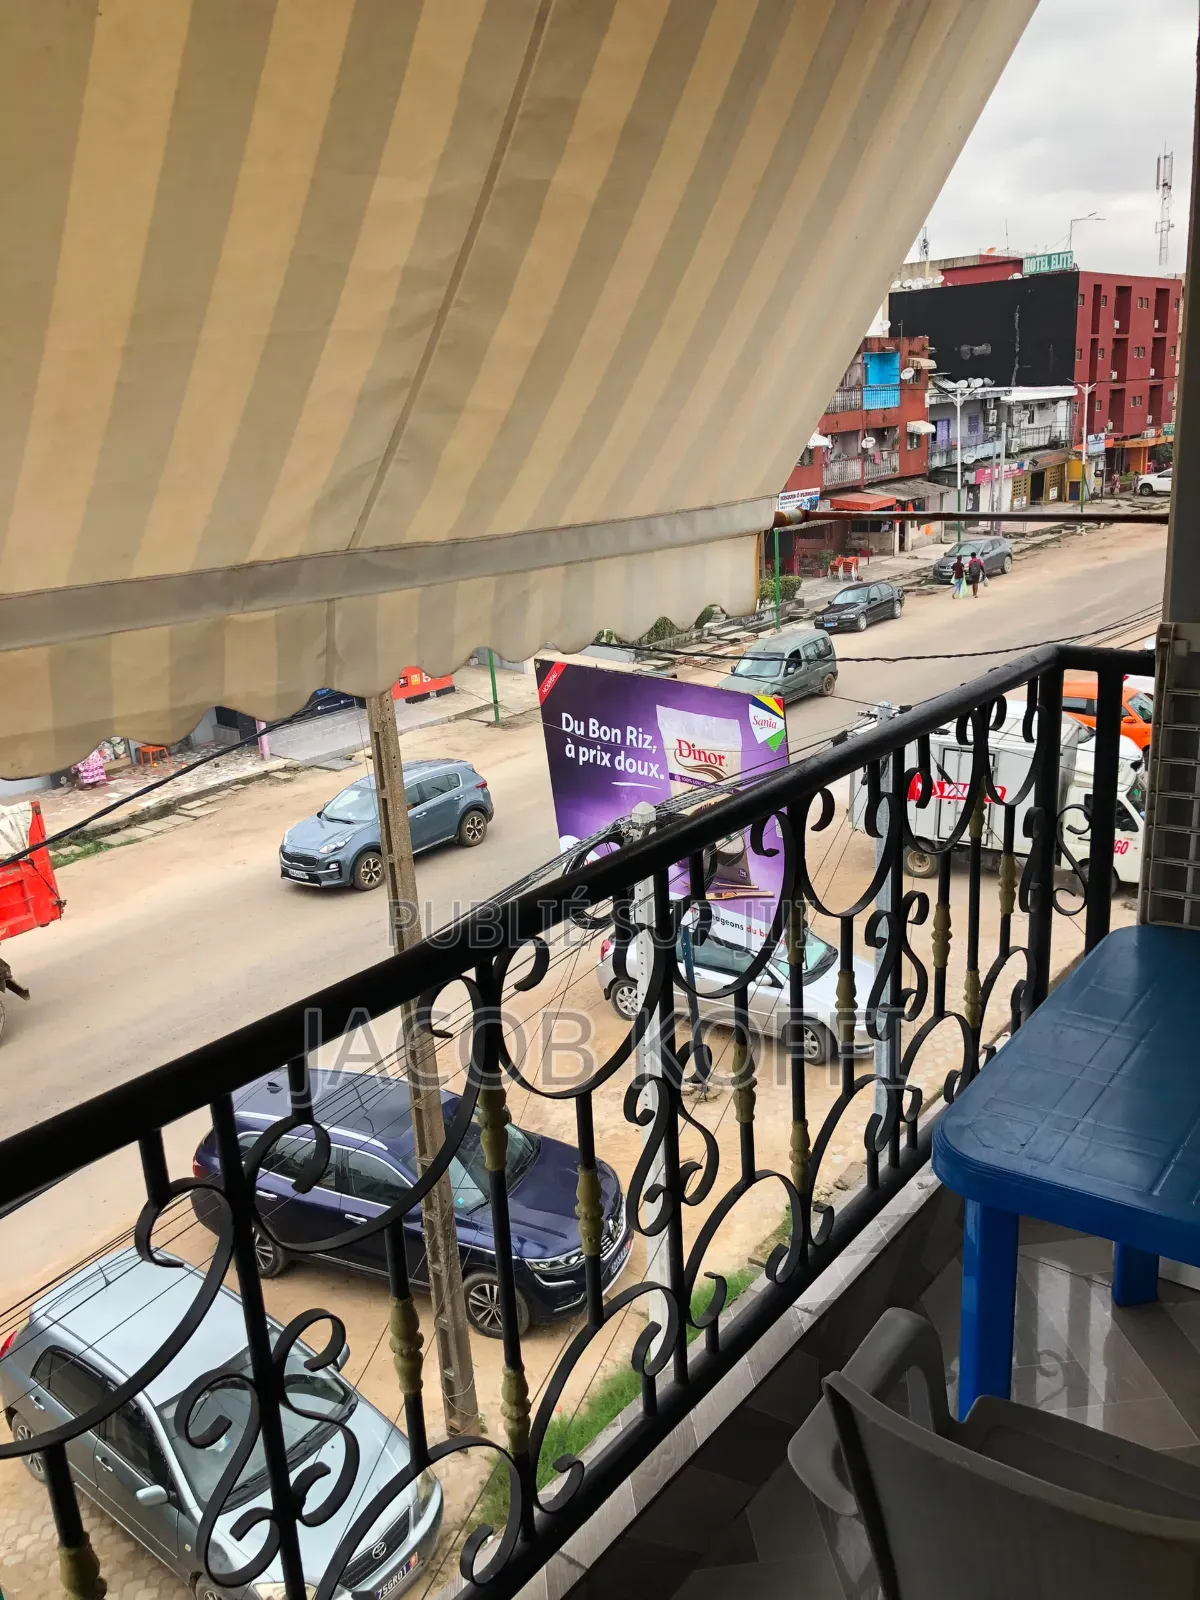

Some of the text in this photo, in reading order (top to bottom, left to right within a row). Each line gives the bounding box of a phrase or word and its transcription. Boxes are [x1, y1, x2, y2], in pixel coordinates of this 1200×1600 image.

[1024, 252, 1073, 272] HOTEL ELITE
[542, 670, 558, 695] NOUVEAU
[561, 712, 657, 754] Du Bon Riz,
[752, 715, 777, 729] Sania
[565, 738, 665, 780] à prix doux.
[676, 738, 726, 767] Dinor
[746, 925, 757, 935] du
